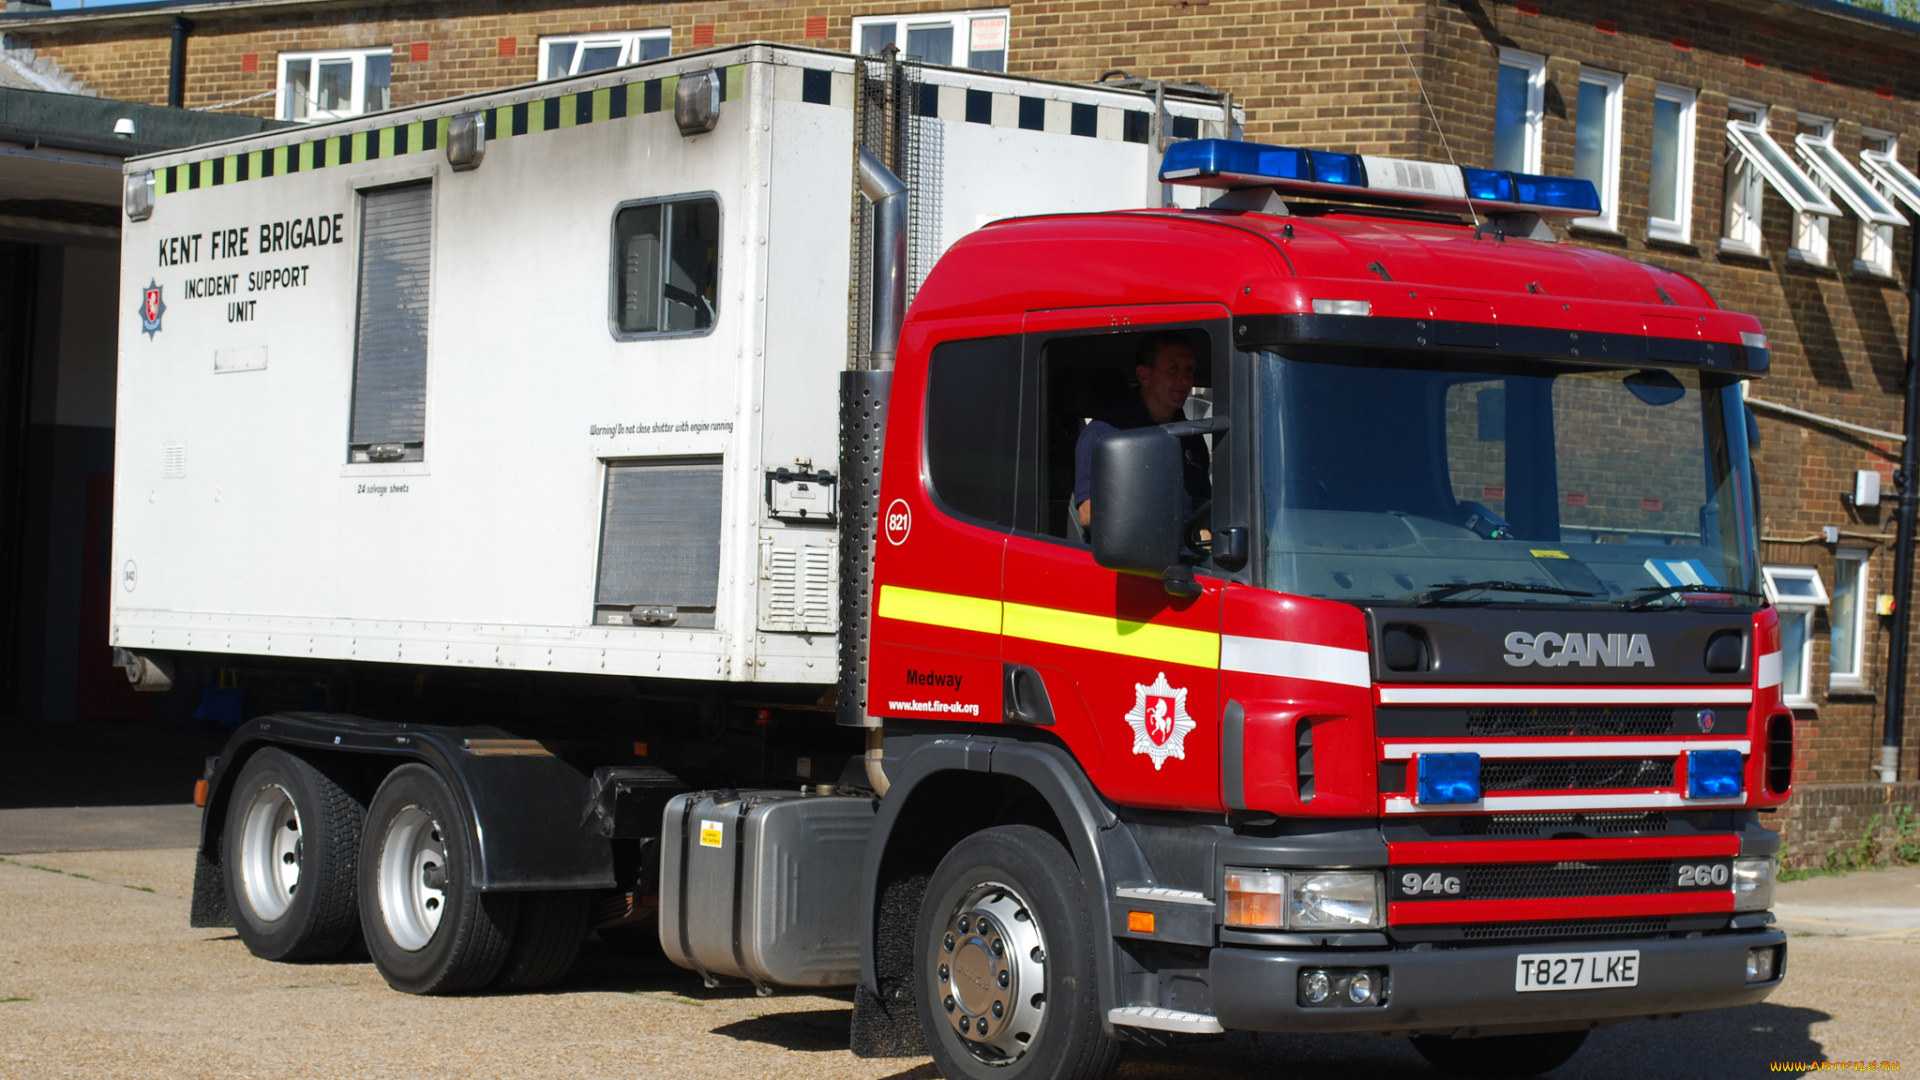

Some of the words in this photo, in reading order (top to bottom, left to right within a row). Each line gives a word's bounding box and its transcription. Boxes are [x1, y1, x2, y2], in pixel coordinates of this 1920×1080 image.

[158, 234, 203, 267] KENT
[211, 227, 249, 261] FIRE
[260, 213, 344, 255] BRIGADE
[185, 274, 239, 300] INCIDENT
[248, 265, 309, 292] SUPPORT
[228, 300, 257, 323] UNIT
[617, 423, 624, 434] Do
[625, 424, 635, 434] not
[636, 423, 650, 434] close
[652, 422, 674, 434] shutter
[675, 420, 689, 433] with
[690, 420, 709, 434] engine
[710, 419, 734, 434] running
[357, 484, 366, 494] 24
[366, 484, 387, 497] salvage
[389, 484, 409, 493] sheets
[889, 513, 908, 531] 821
[1503, 631, 1655, 667] SCANIA
[906, 669, 962, 691] Medway
[888, 699, 980, 716] www.kent.fire-uk.org
[1402, 872, 1461, 895] 94G
[1678, 864, 1728, 887] 260
[1520, 957, 1585, 986] T827
[1591, 955, 1637, 984] LKE
